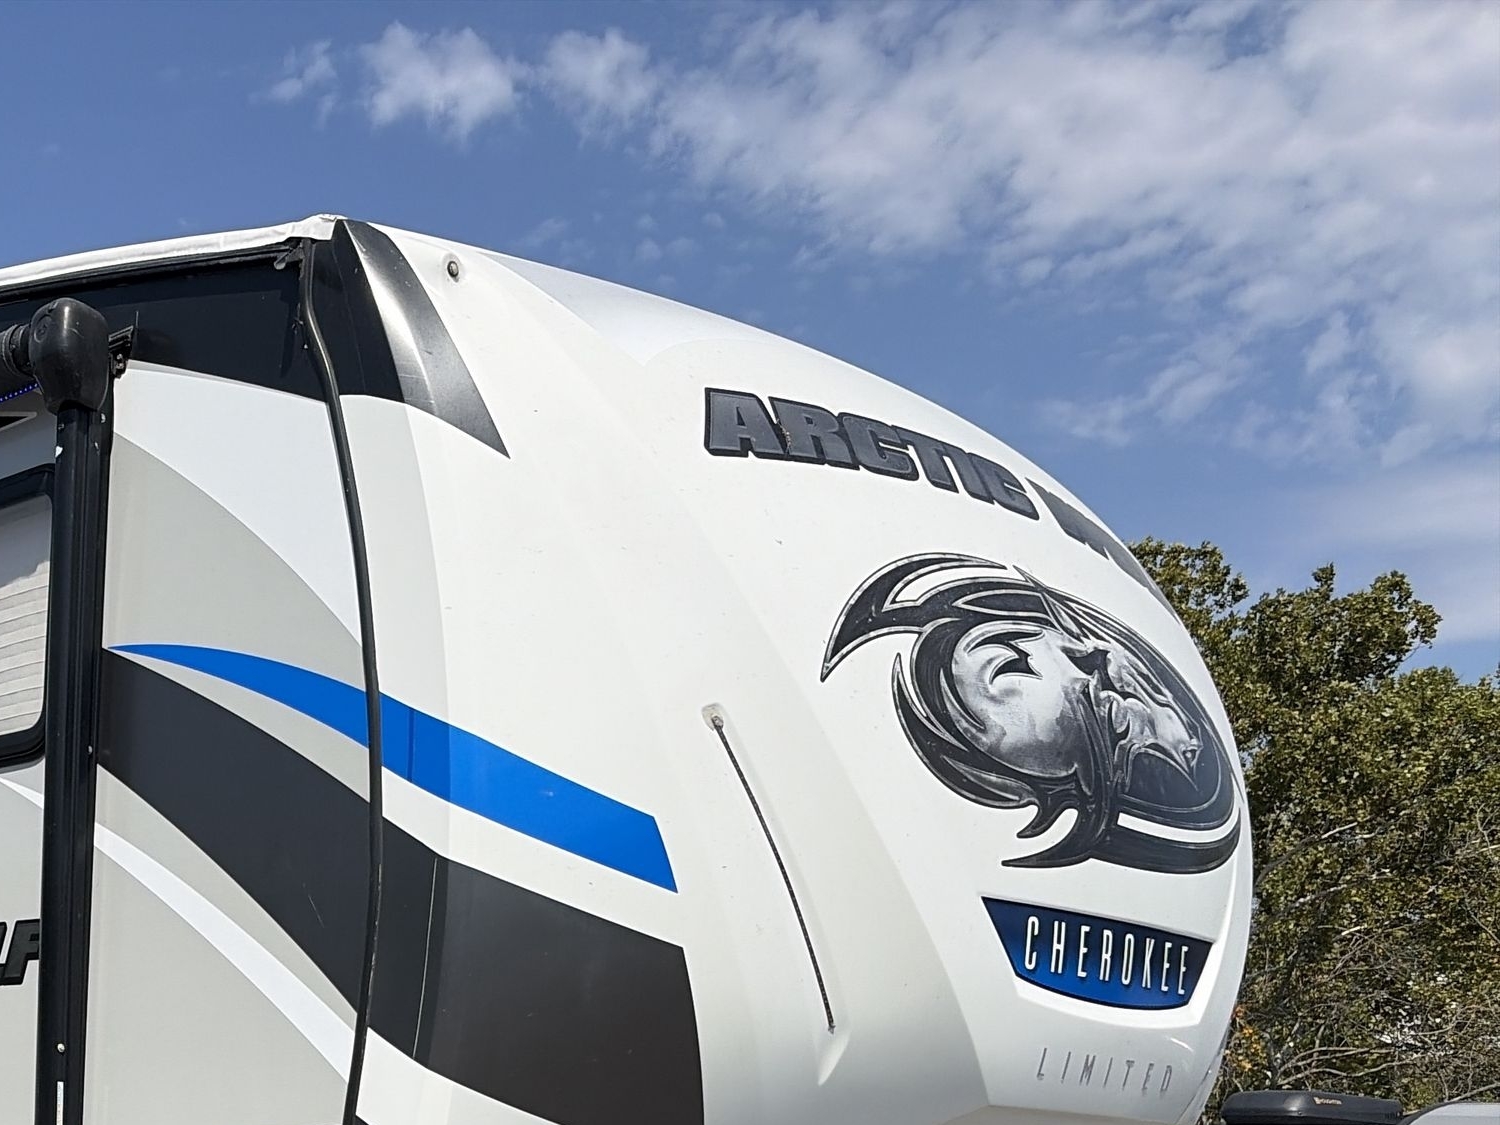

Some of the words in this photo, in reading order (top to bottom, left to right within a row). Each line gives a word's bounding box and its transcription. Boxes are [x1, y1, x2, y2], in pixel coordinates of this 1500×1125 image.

[704, 387, 1040, 520] ARCTIC
[1024, 915, 1189, 995] CHEROKEE
[1036, 1047, 1174, 1093] LIMITED
